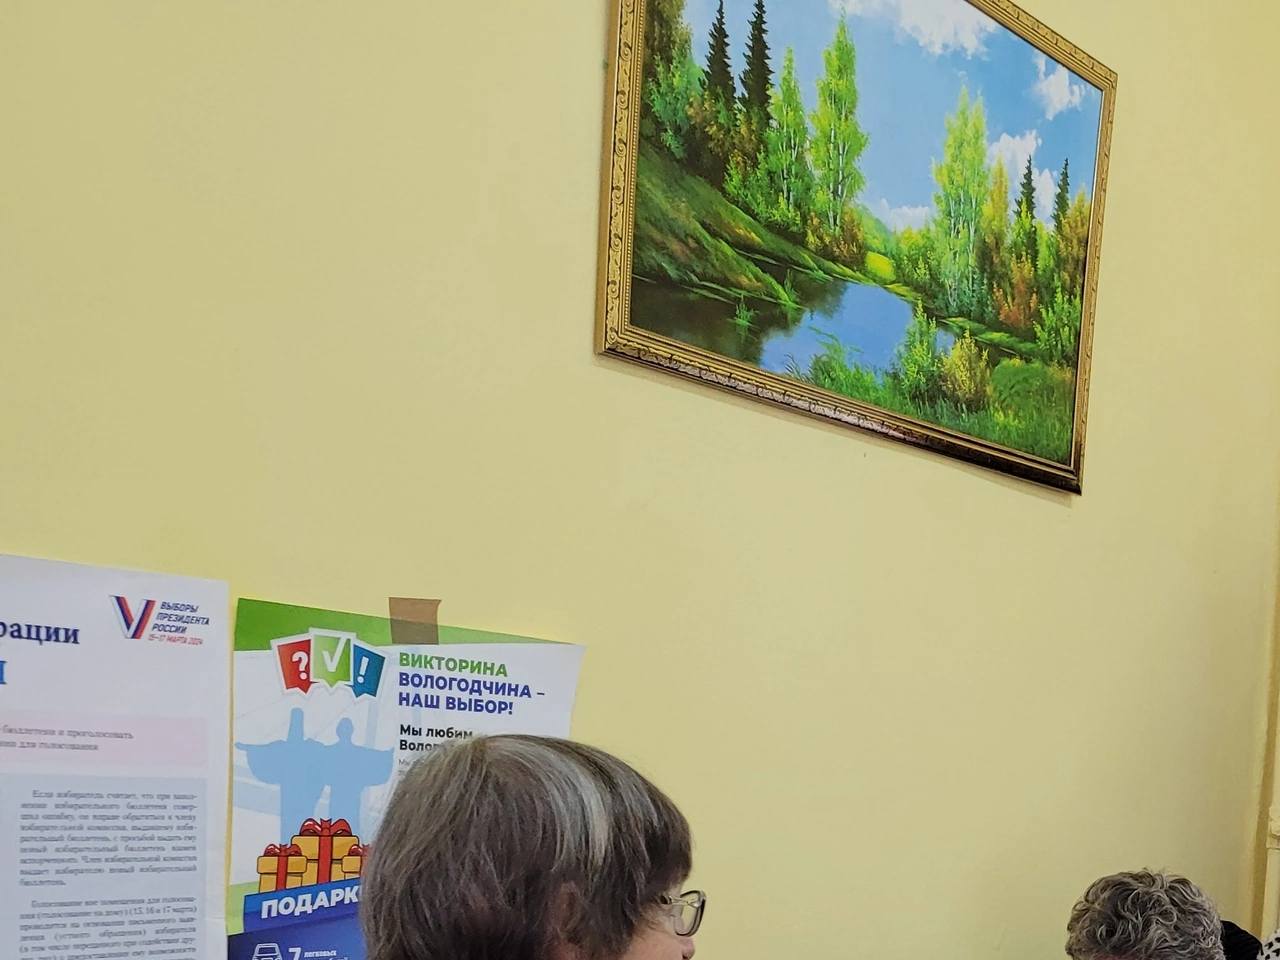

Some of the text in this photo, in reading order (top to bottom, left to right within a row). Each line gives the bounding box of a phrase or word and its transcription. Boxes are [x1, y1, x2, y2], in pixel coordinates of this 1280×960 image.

[160, 601, 199, 613] ВЫБОРЫ
[156, 612, 210, 626] ПРЕЗИДЕНТА
[152, 623, 188, 634] РОССИИ
[399, 652, 508, 678] ВИКТОРИНА
[399, 672, 532, 699] ВОЛОГОДЧИНА
[399, 692, 514, 715] НАШ ВЫБОР!
[400, 724, 422, 737] Мы
